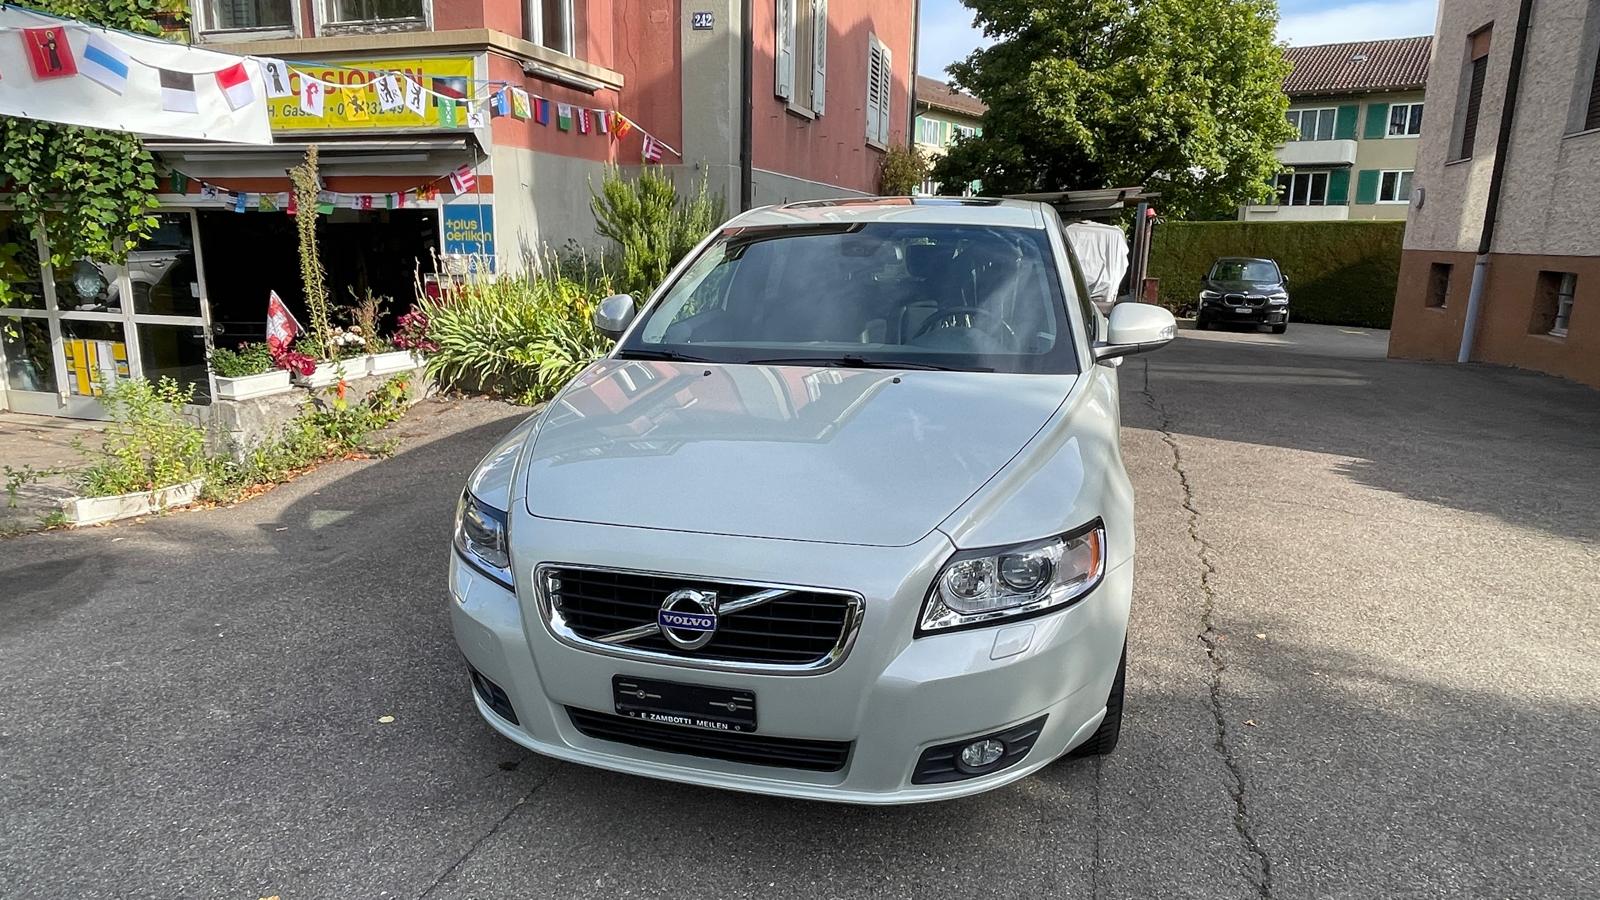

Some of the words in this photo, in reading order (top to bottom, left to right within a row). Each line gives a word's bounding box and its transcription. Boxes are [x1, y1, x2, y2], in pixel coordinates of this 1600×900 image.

[695, 13, 712, 27] 242
[662, 614, 712, 627] VOLVO
[650, 713, 692, 725] ZAMBOTTI
[696, 719, 728, 730] MEILEN
